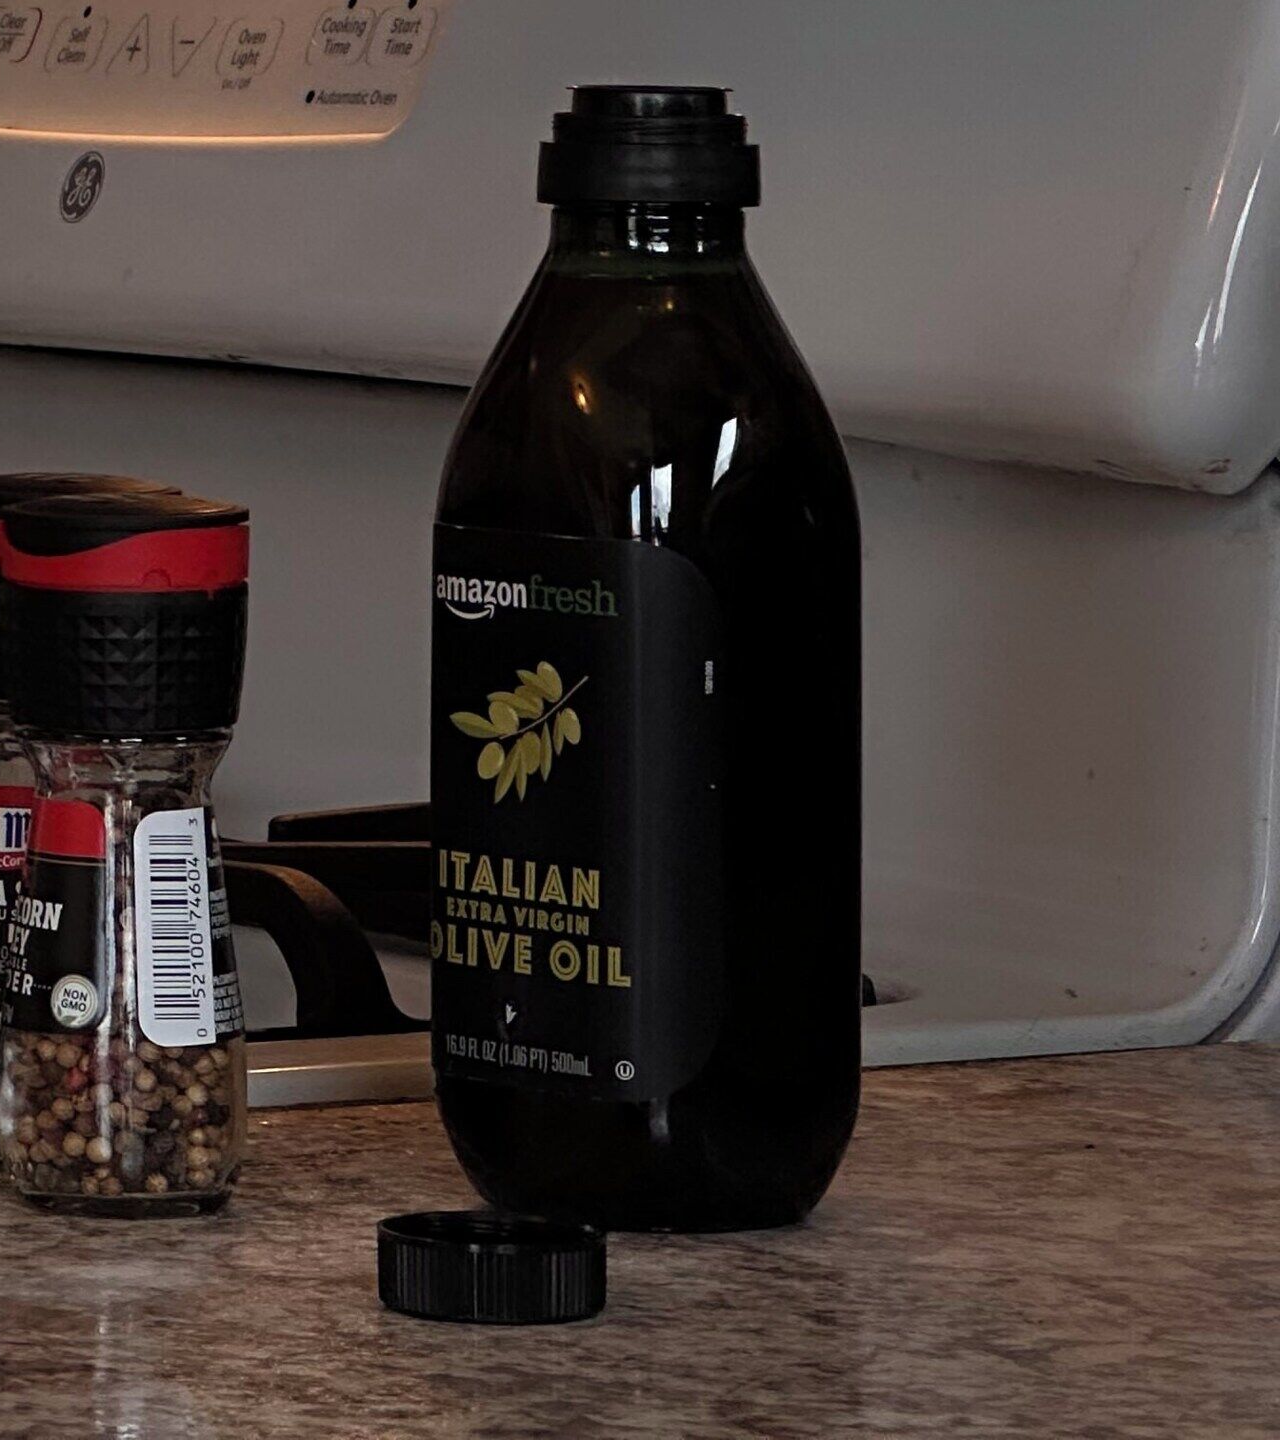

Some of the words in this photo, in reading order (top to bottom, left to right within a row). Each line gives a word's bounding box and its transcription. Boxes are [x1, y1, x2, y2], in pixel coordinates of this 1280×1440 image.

[0, 13, 28, 29] Clear
[322, 17, 367, 38] Cooking
[390, 18, 422, 34] Start
[69, 26, 92, 43] Self
[238, 28, 267, 45] Oven
[324, 39, 352, 55] Time
[385, 39, 413, 55] Time
[231, 50, 260, 69] Light
[370, 89, 398, 105] Oven
[189, 818, 198, 827] 3
[439, 849, 600, 910] ITALIAN
[188, 857, 202, 920] 74604
[446, 896, 507, 925] EXTRA
[513, 906, 590, 936] VIRGIN
[190, 932, 206, 998] 52100
[549, 939, 631, 988] OIL
[63, 988, 88, 1002] NON
[61, 999, 87, 1012] GMO
[197, 1028, 207, 1037] 0
[446, 1034, 466, 1056] 16.9
[468, 1038, 480, 1059] FL
[482, 1040, 497, 1062] OZ
[551, 1051, 593, 1076] 500mL
